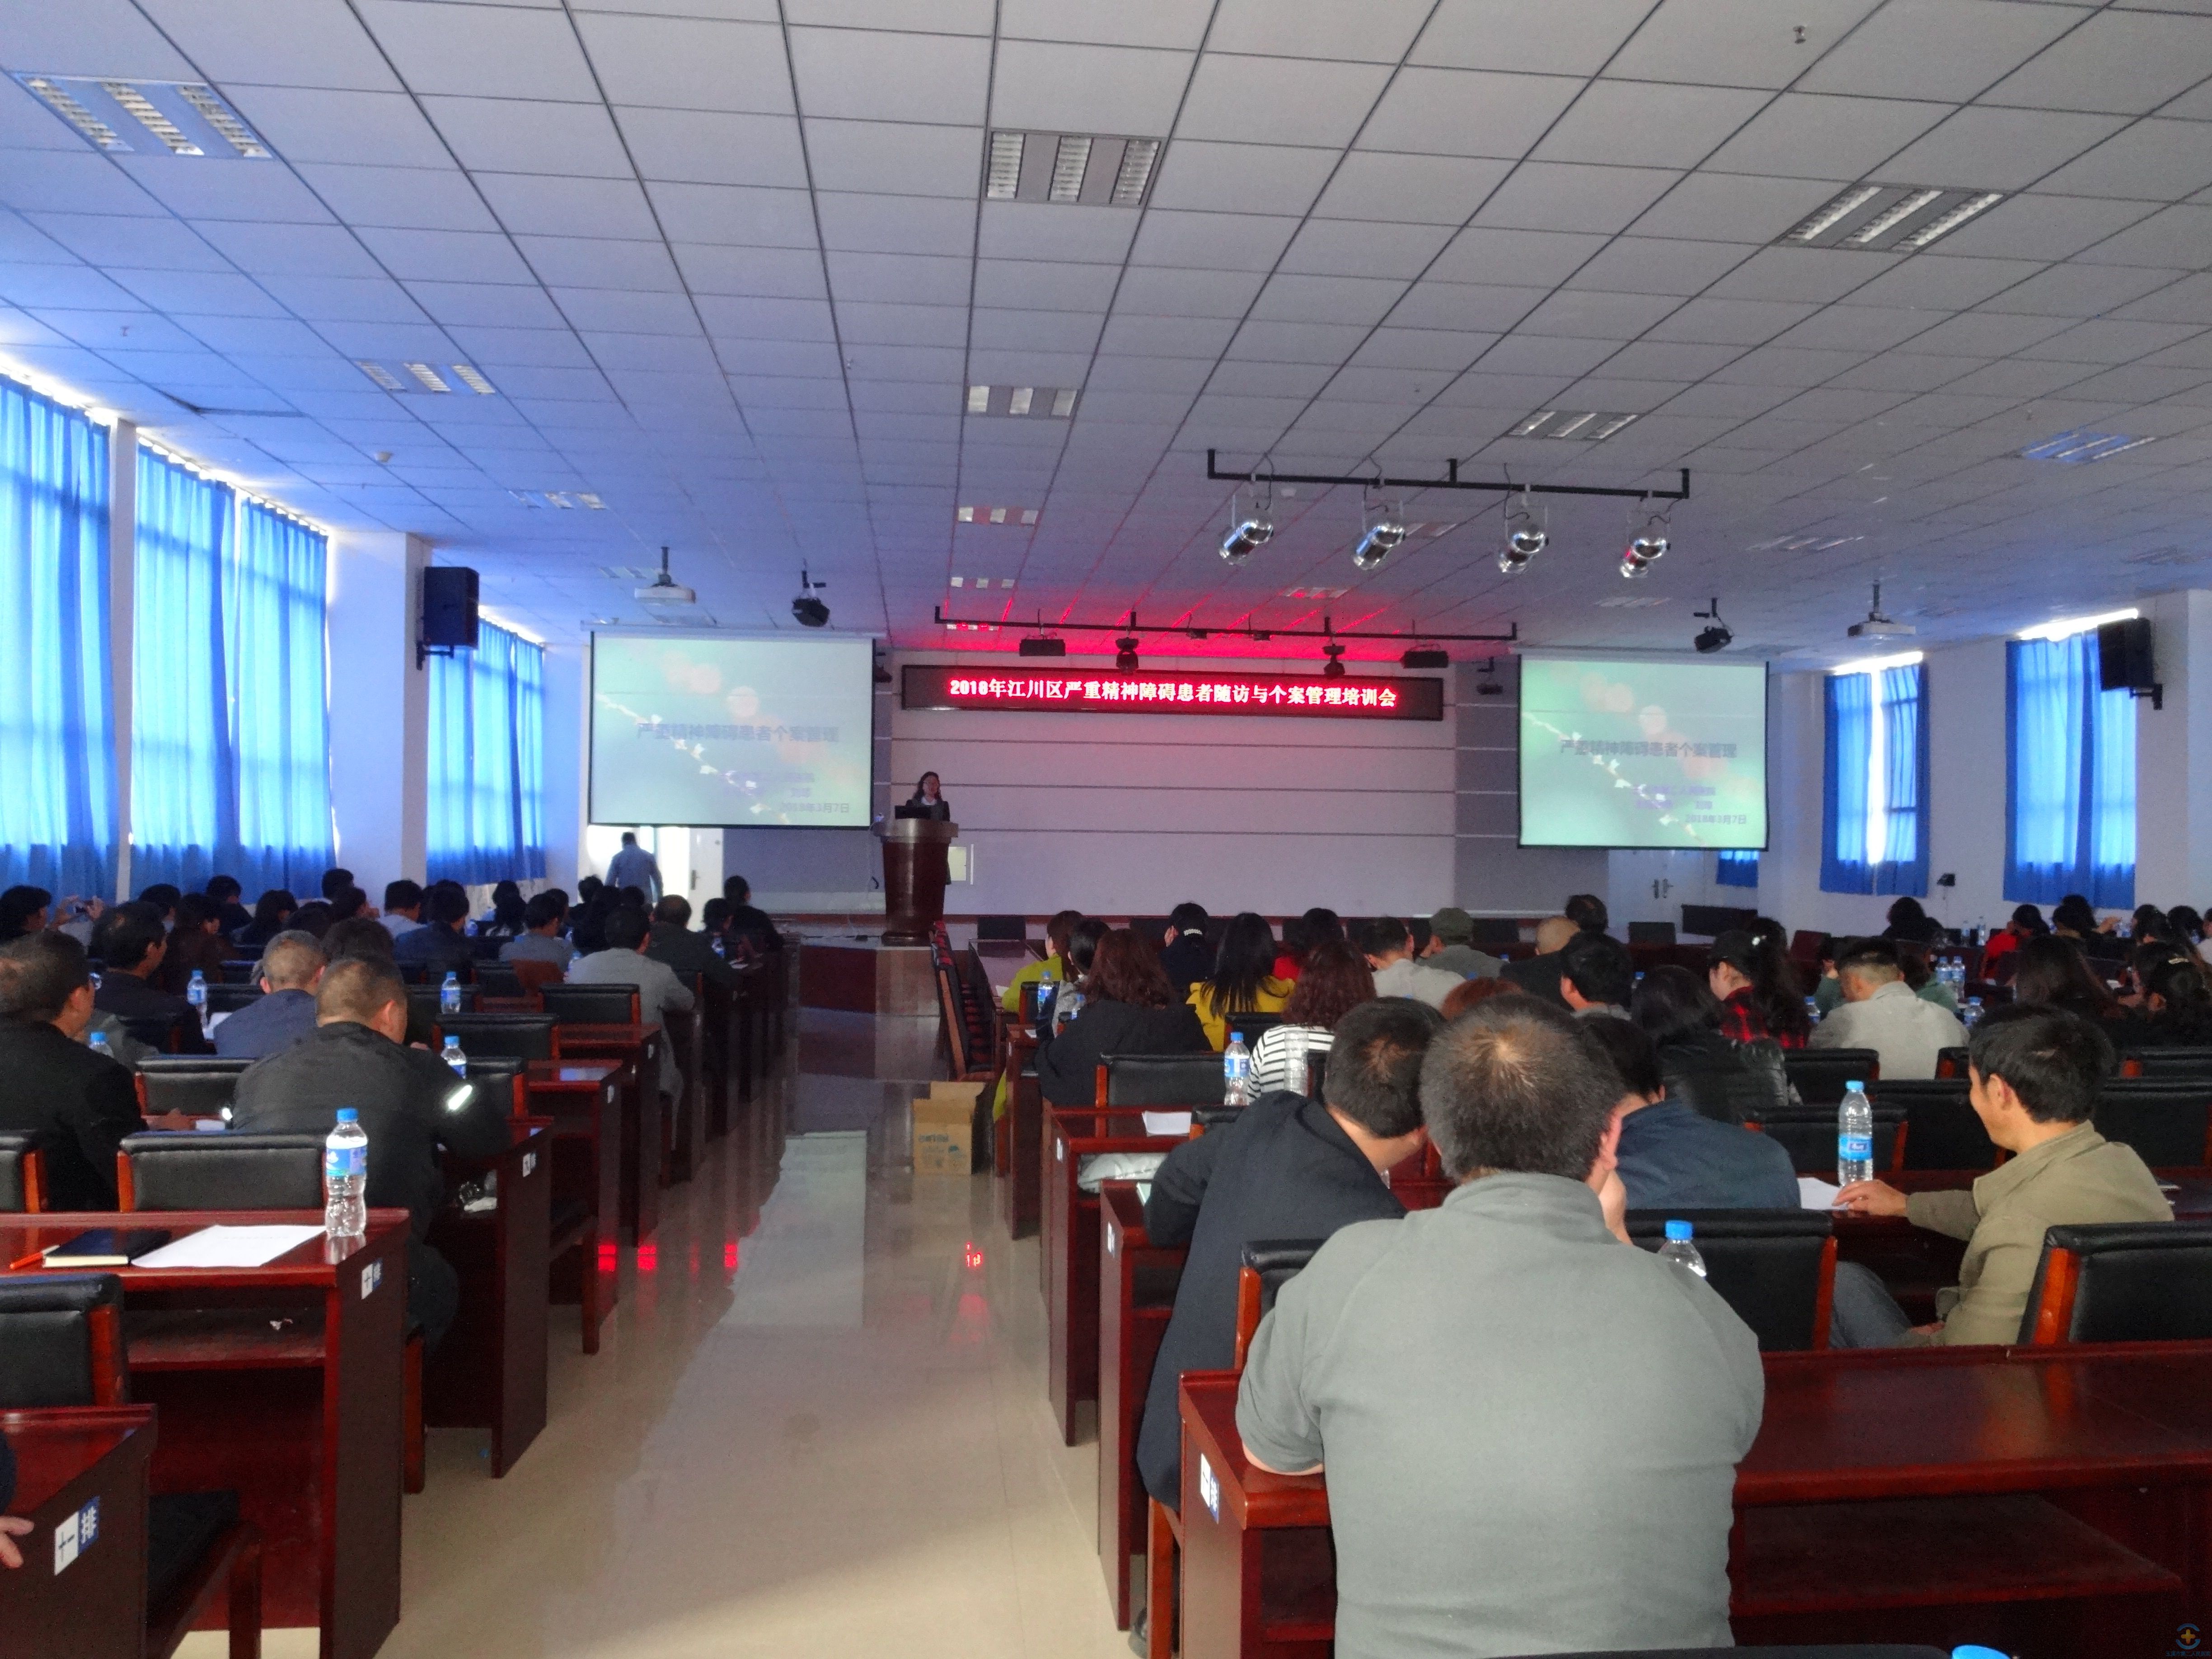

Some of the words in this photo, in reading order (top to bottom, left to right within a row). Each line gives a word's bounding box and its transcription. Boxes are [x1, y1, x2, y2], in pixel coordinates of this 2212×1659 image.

[950, 679, 1397, 707] 2018年江川区严重精神障碍患者随访与个案管理培训会
